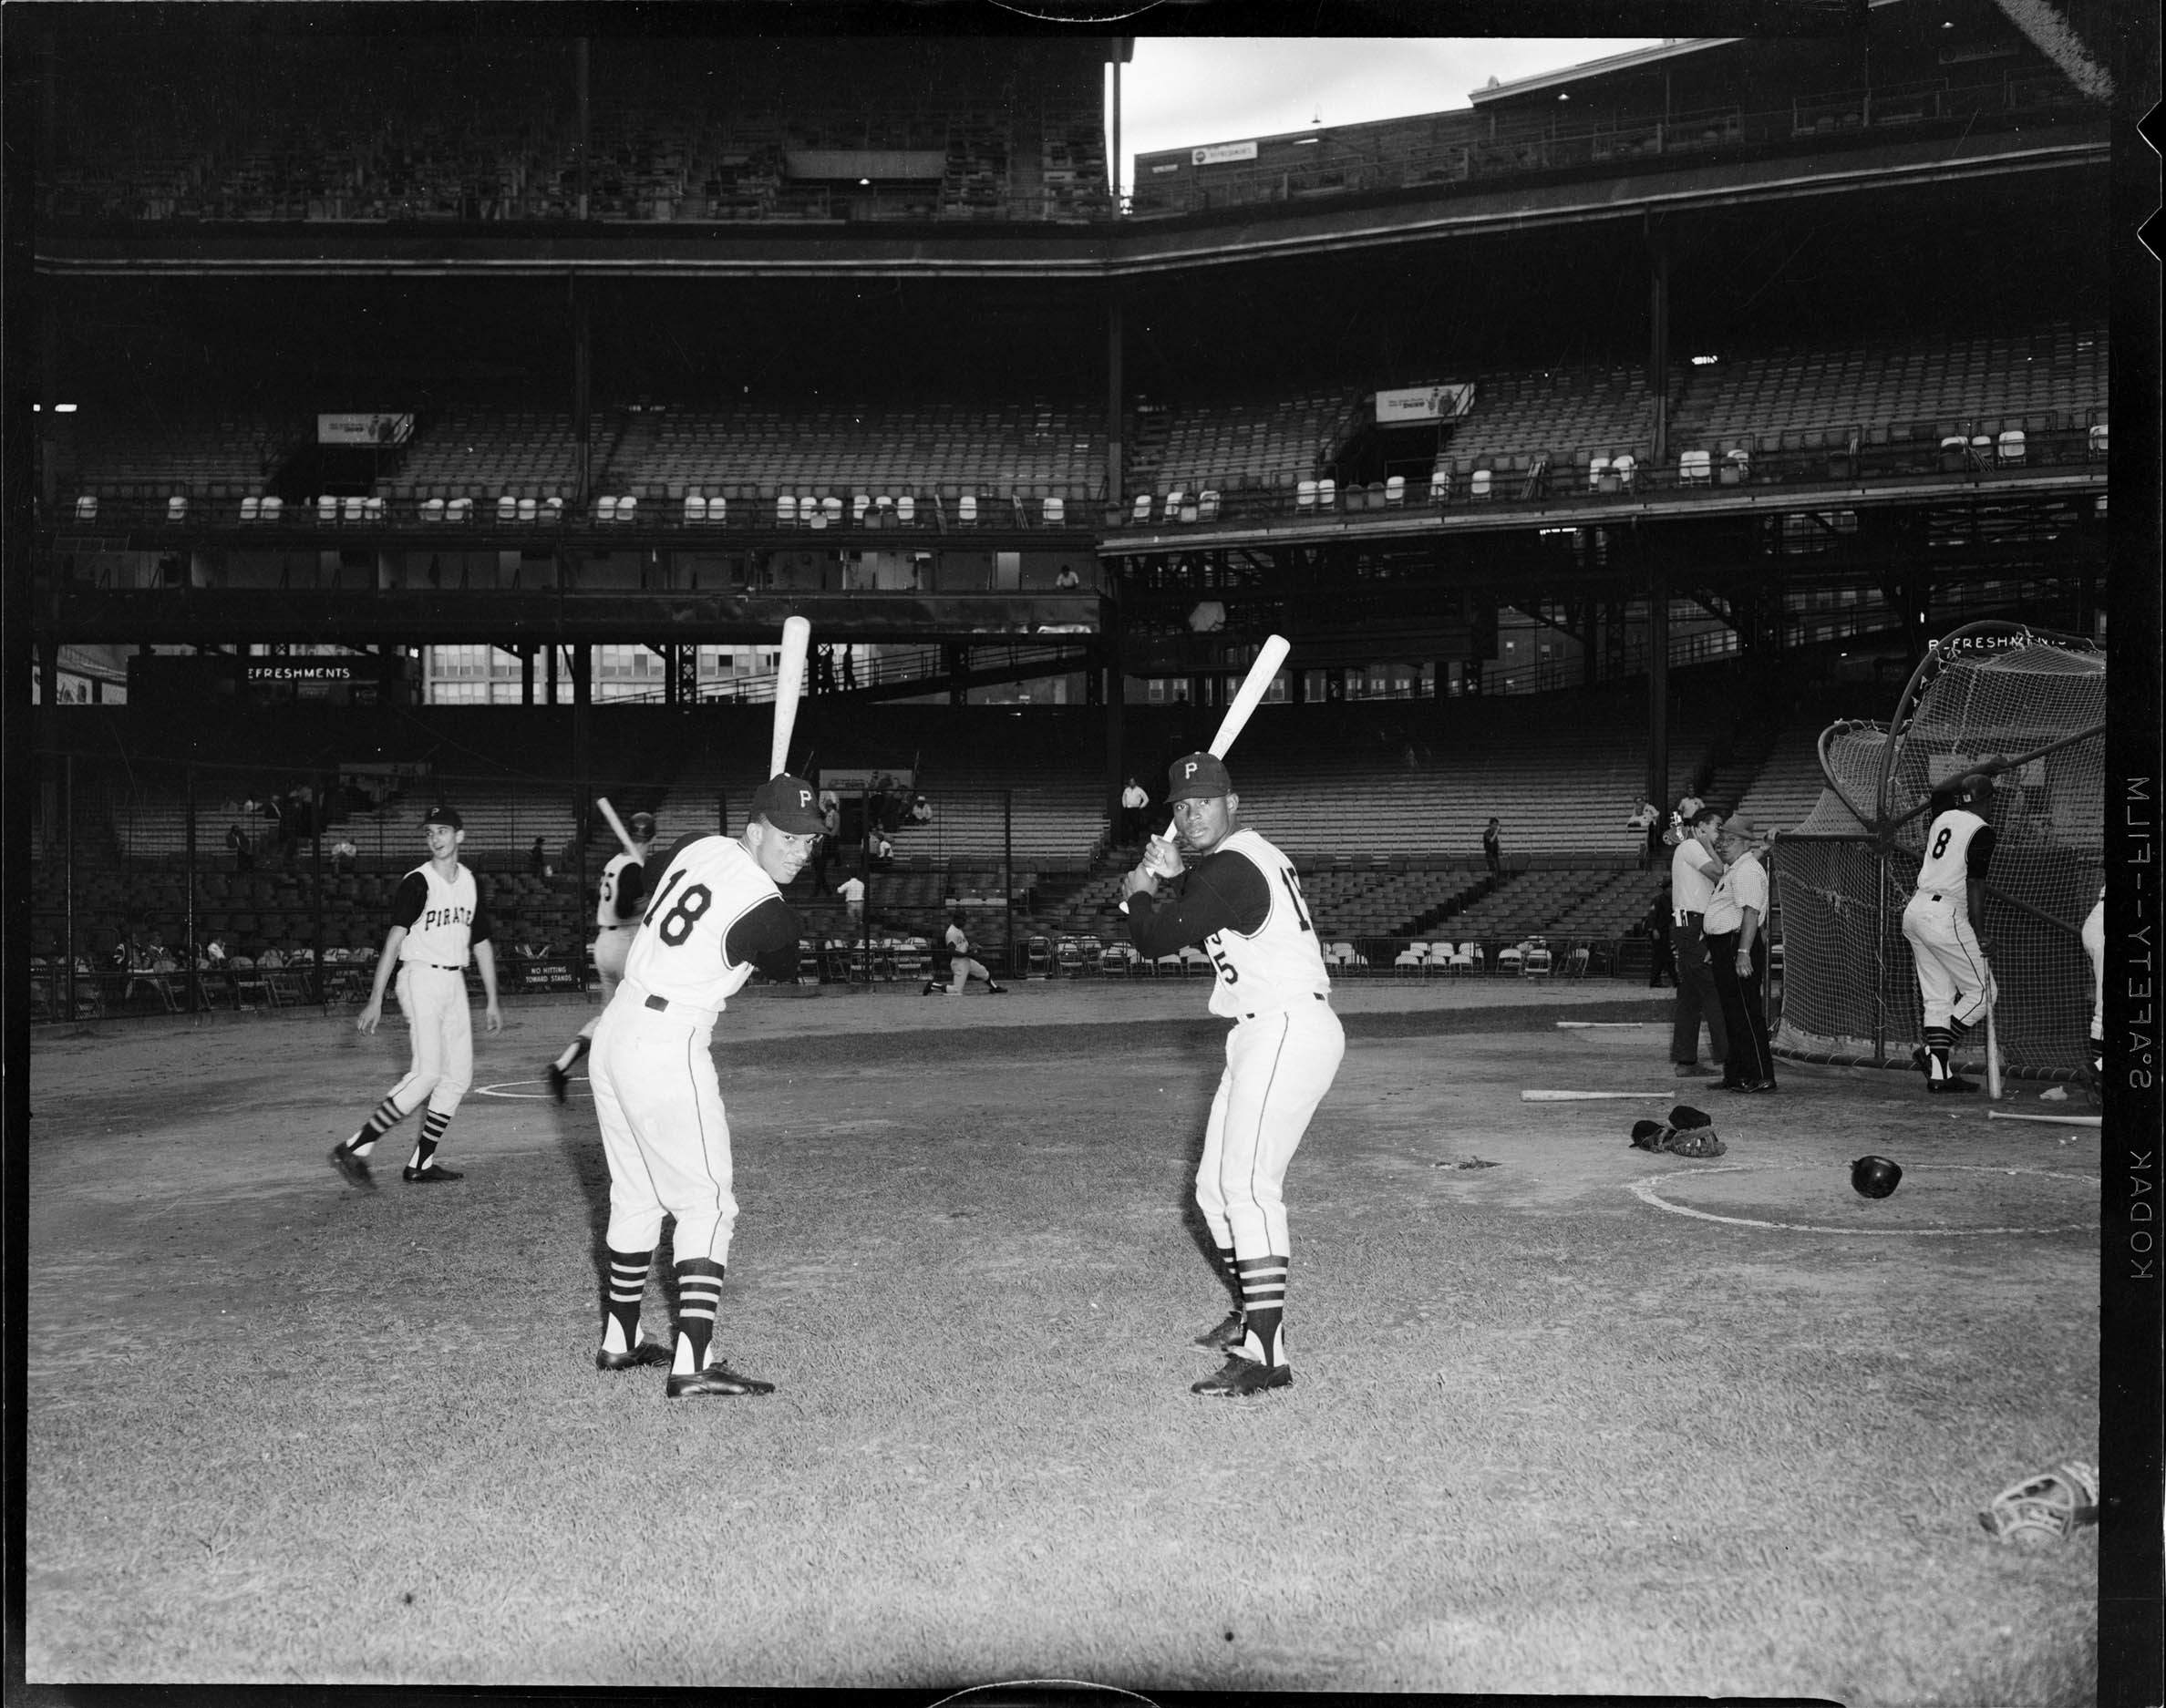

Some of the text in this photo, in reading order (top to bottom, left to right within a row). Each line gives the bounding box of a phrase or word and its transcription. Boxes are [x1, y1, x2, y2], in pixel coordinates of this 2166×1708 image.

[1185, 762, 1198, 779] P
[799, 790, 812, 808] P
[1933, 827, 1952, 859] 8
[644, 869, 712, 947] 18
[543, 966, 567, 974] HITTING
[1213, 951, 1238, 985] 5
